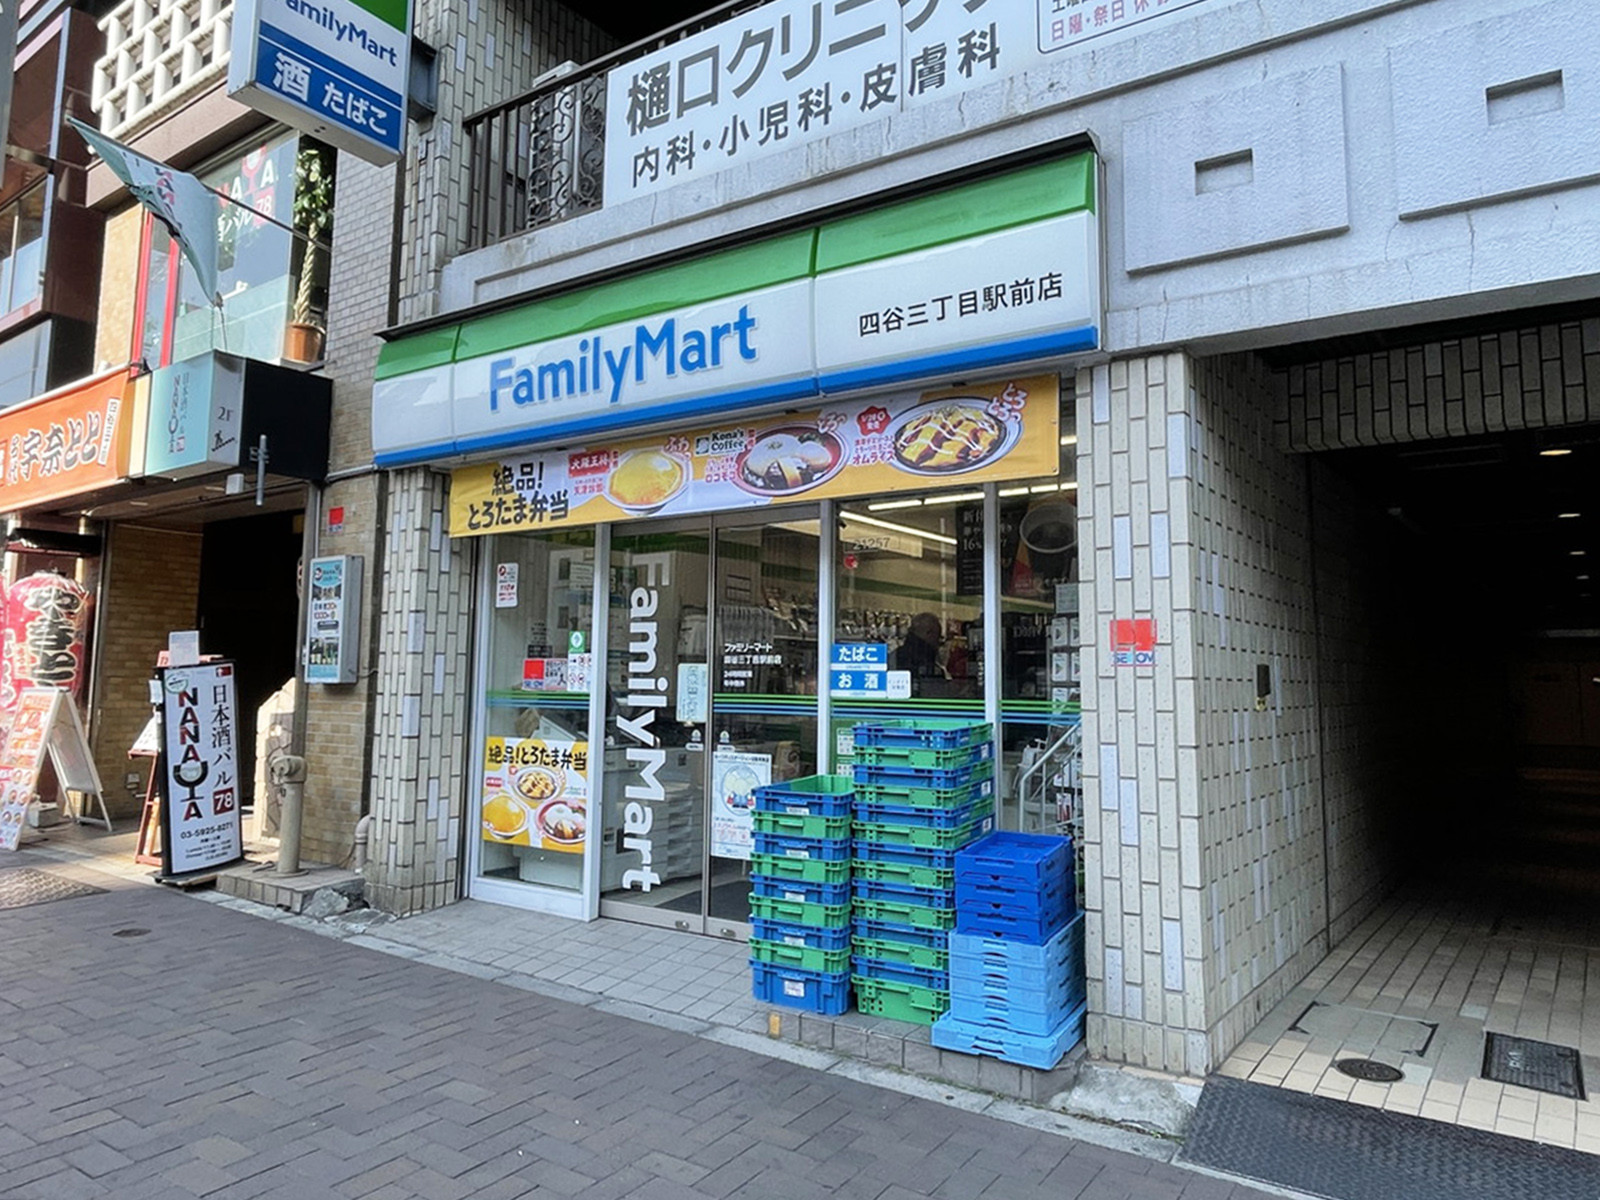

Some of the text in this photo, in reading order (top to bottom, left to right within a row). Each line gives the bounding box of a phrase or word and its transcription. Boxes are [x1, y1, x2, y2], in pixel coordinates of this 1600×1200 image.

[274, 0, 398, 67] amilyMart
[626, 0, 995, 137] 樋口クリニ
[272, 51, 388, 136] 酒 たばこ
[859, 273, 1064, 337] 四谷三丁目駅前店
[489, 304, 757, 404] FamilyMart
[711, 429, 745, 442] Kona's
[711, 439, 745, 452] Coffee
[705, 470, 737, 483] ロコモコ
[852, 450, 896, 465] オムライス
[492, 461, 544, 496] 絶品!
[467, 489, 569, 530] とろたま弁当
[724, 643, 773, 653] ファミリーマート
[838, 646, 879, 662] たばこ
[616, 552, 672, 893] FamilyMart
[210, 684, 234, 813] 日本酒バル 78
[488, 745, 587, 771] 絶品!とろたま弁当
